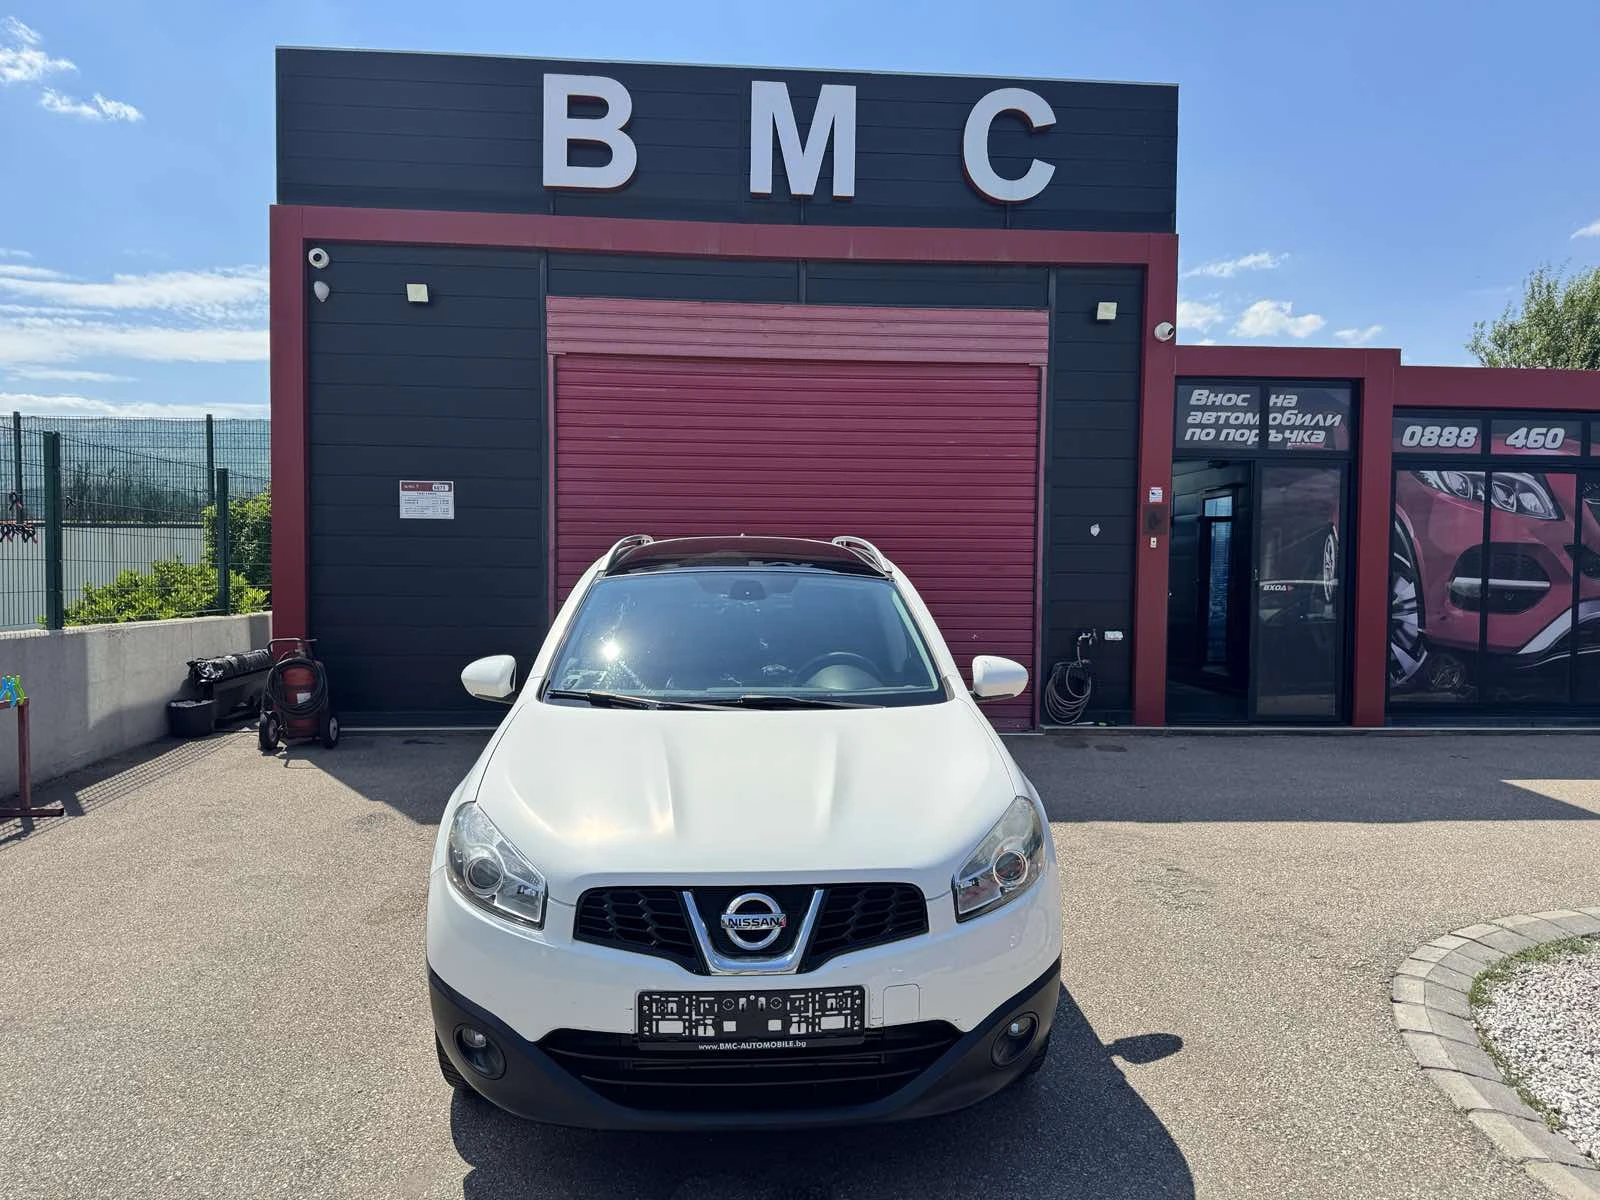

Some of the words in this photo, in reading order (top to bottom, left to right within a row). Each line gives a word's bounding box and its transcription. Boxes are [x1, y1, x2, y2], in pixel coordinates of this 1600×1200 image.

[1189, 389, 1250, 406] Внос
[1269, 394, 1298, 407] на
[1187, 410, 1342, 427] автомобили
[1185, 428, 1216, 441] по
[1402, 425, 1479, 448] 0888
[1505, 426, 1565, 449] 460
[728, 917, 780, 927] NISSAN
[699, 1040, 807, 1050] www.BMC-AUTOMOBILE.bg
